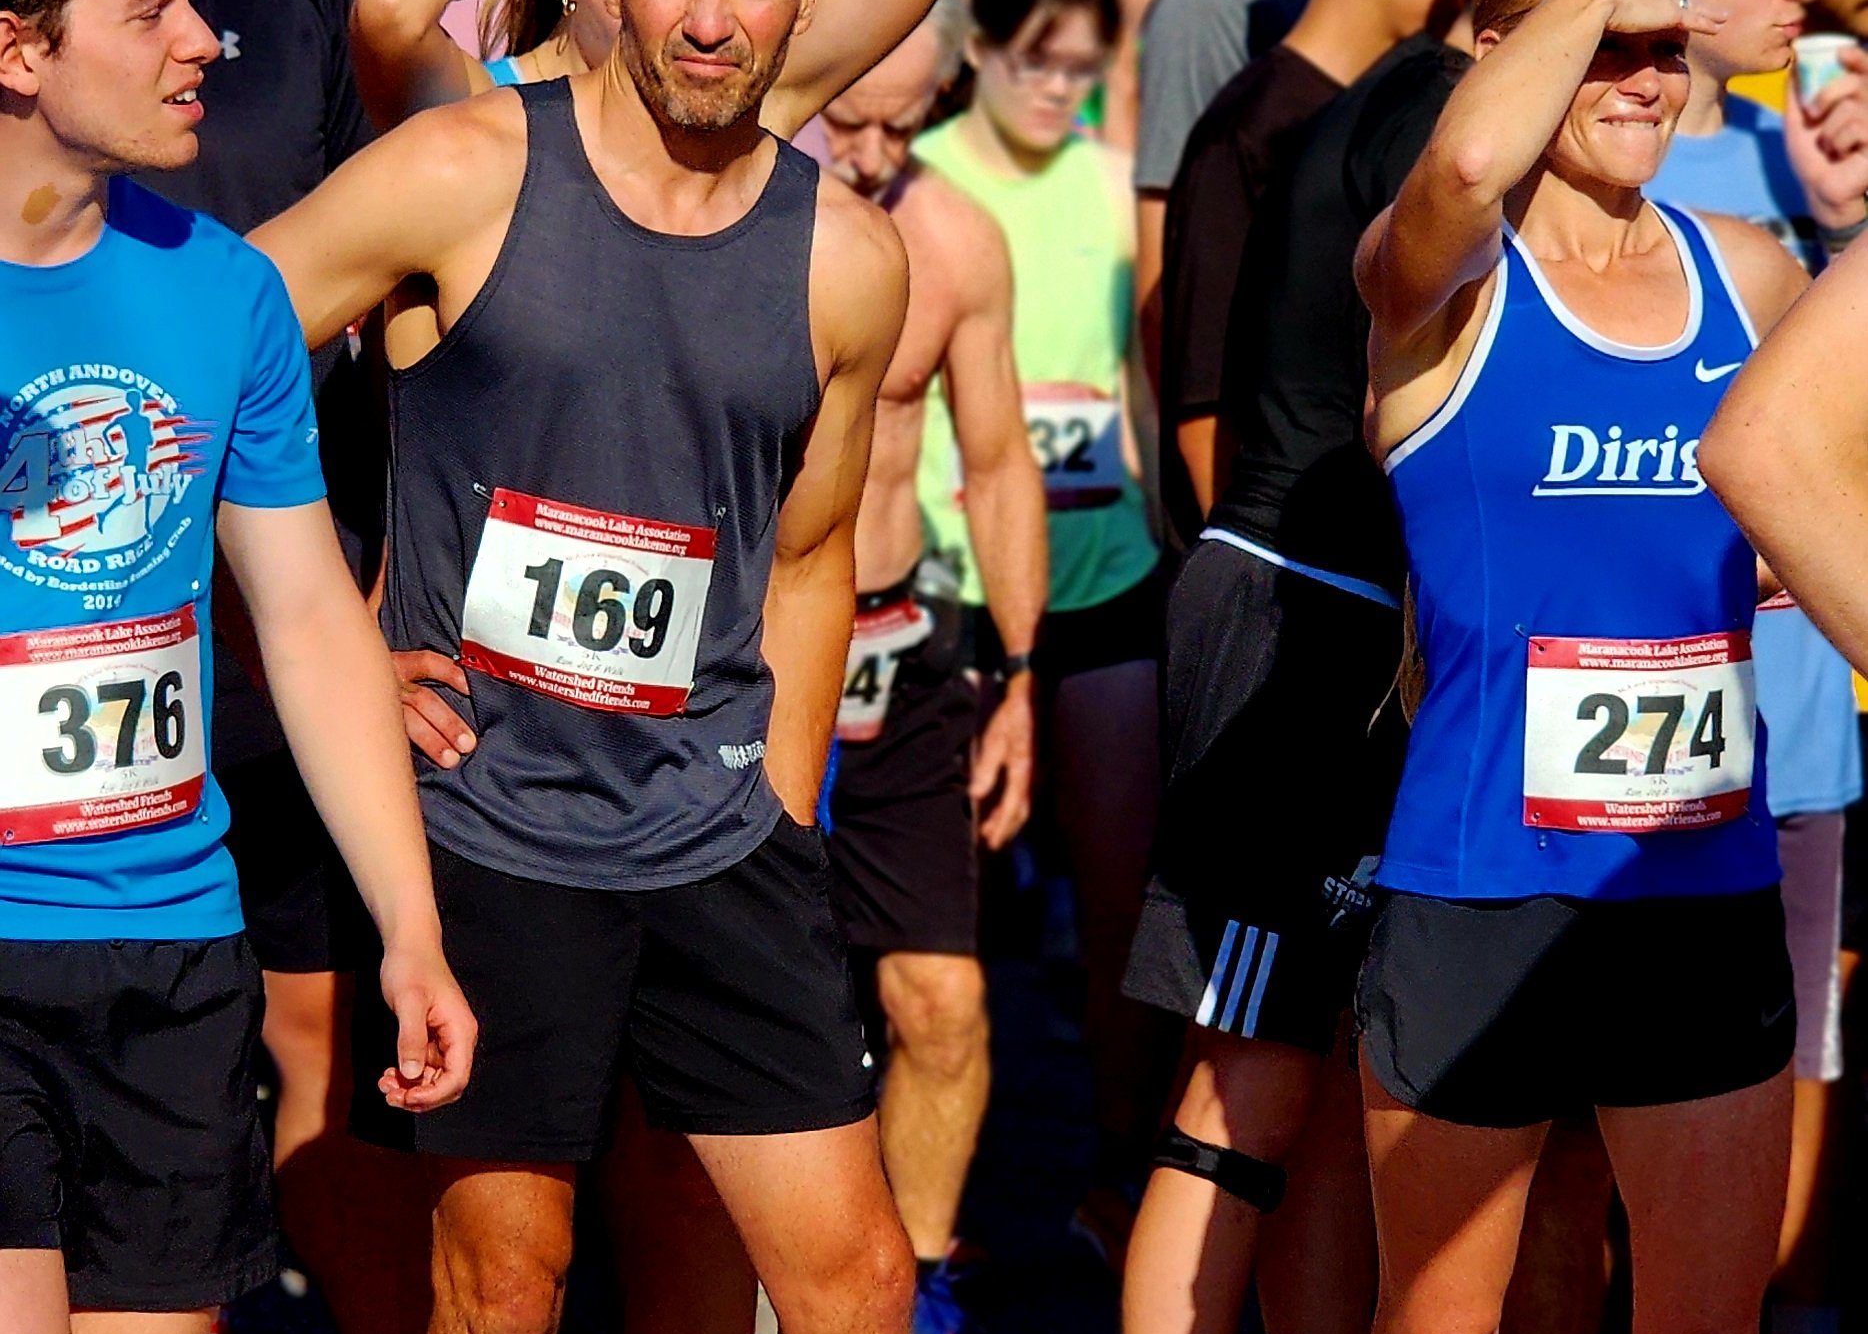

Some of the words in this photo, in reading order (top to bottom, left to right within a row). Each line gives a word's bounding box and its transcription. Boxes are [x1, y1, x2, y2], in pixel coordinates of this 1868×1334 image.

[1, 368, 66, 429] NORTH
[68, 363, 179, 415] ANDOVER
[62, 466, 111, 503] of
[119, 463, 193, 505] July
[535, 503, 607, 531] Maranacook
[607, 516, 635, 536] Lake
[634, 524, 691, 543] Association
[26, 549, 101, 574] ROAD
[104, 533, 154, 571] RACE
[24, 569, 46, 586] by
[524, 557, 675, 659] 169
[27, 630, 104, 651] Maranacook
[104, 623, 133, 644] Lake
[1577, 642, 1652, 657] Maranacook
[1652, 641, 1680, 657] Lake
[1679, 638, 1729, 655] Association
[508, 670, 651, 710] www.watershedfriends.com
[534, 665, 596, 690] Watershed
[596, 678, 636, 696] Friends
[38, 670, 186, 776] 376
[1573, 689, 1726, 775] 274
[80, 795, 139, 817] Watershed
[139, 789, 173, 809] Friends
[1604, 802, 1667, 816] Watershed
[1667, 799, 1707, 814] Friends
